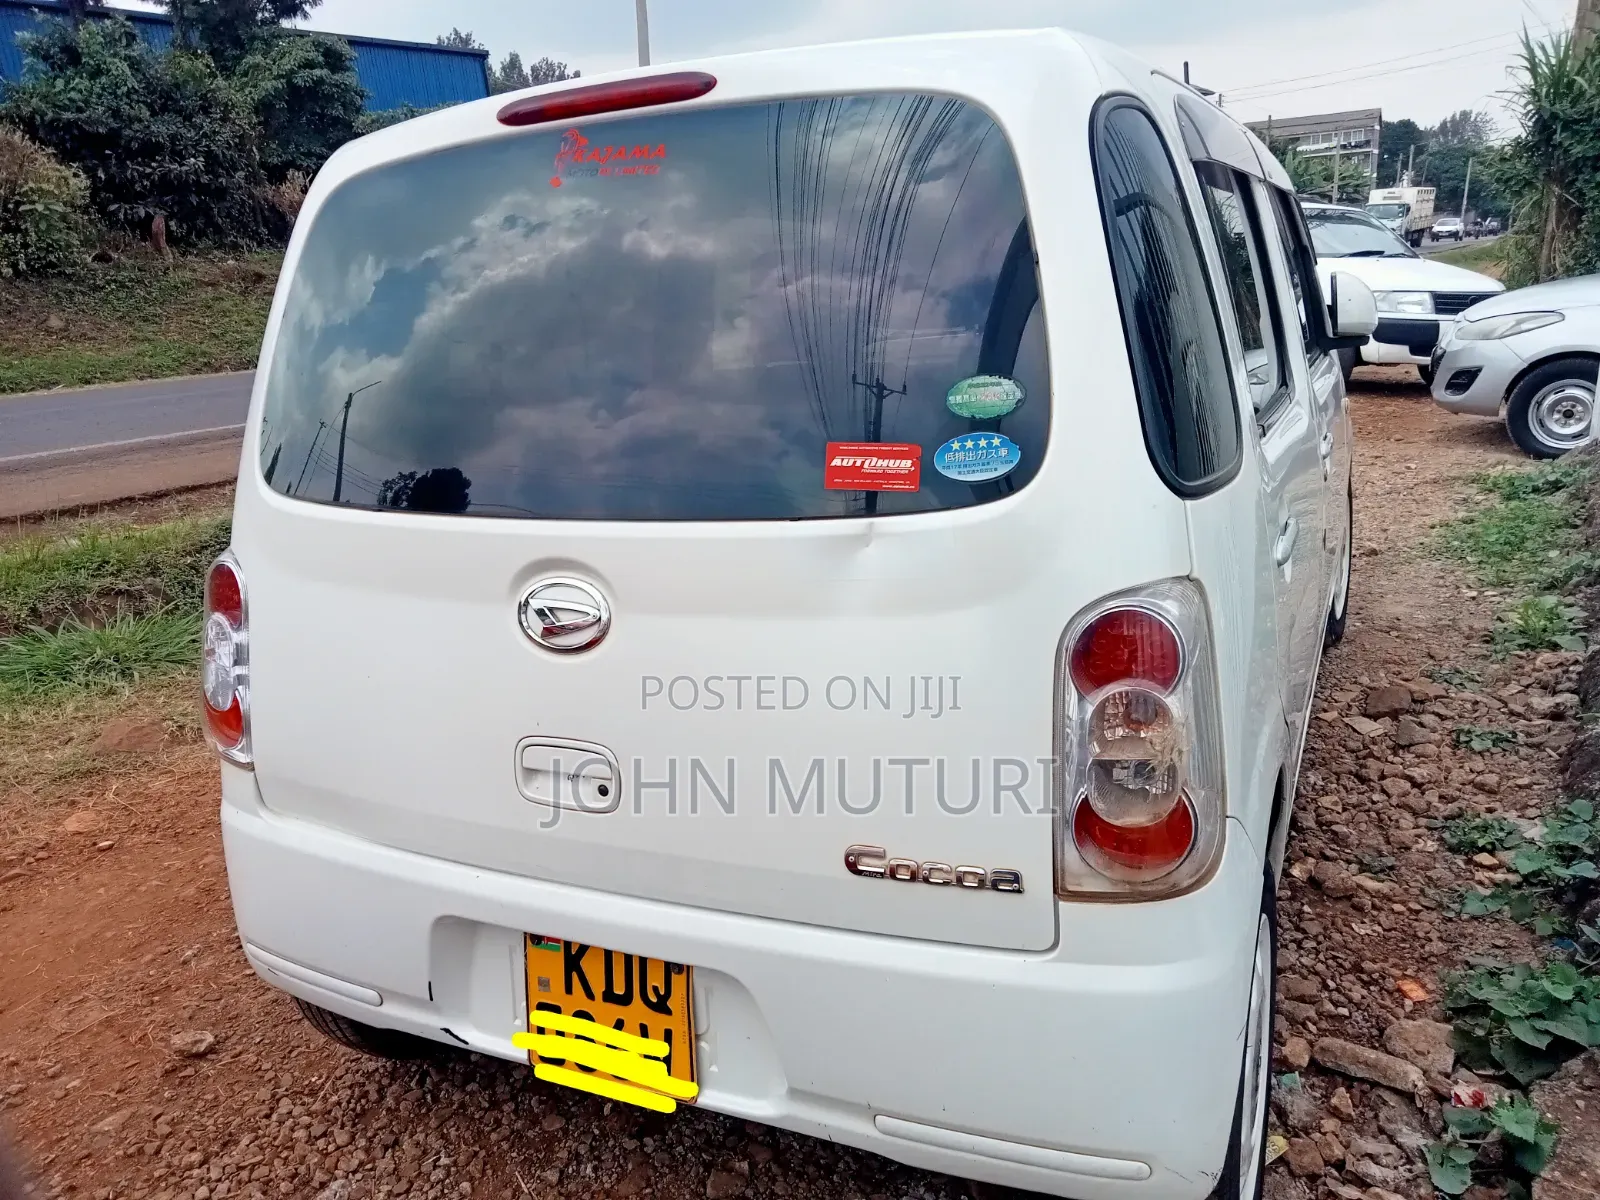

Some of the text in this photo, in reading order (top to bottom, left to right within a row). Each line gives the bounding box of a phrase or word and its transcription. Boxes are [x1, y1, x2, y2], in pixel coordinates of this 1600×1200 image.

[829, 456, 913, 469] AUTOHUB
[945, 447, 1009, 463] 低排出ガス車
[844, 844, 1025, 894] Cocoa
[563, 940, 673, 1016] KDQ
